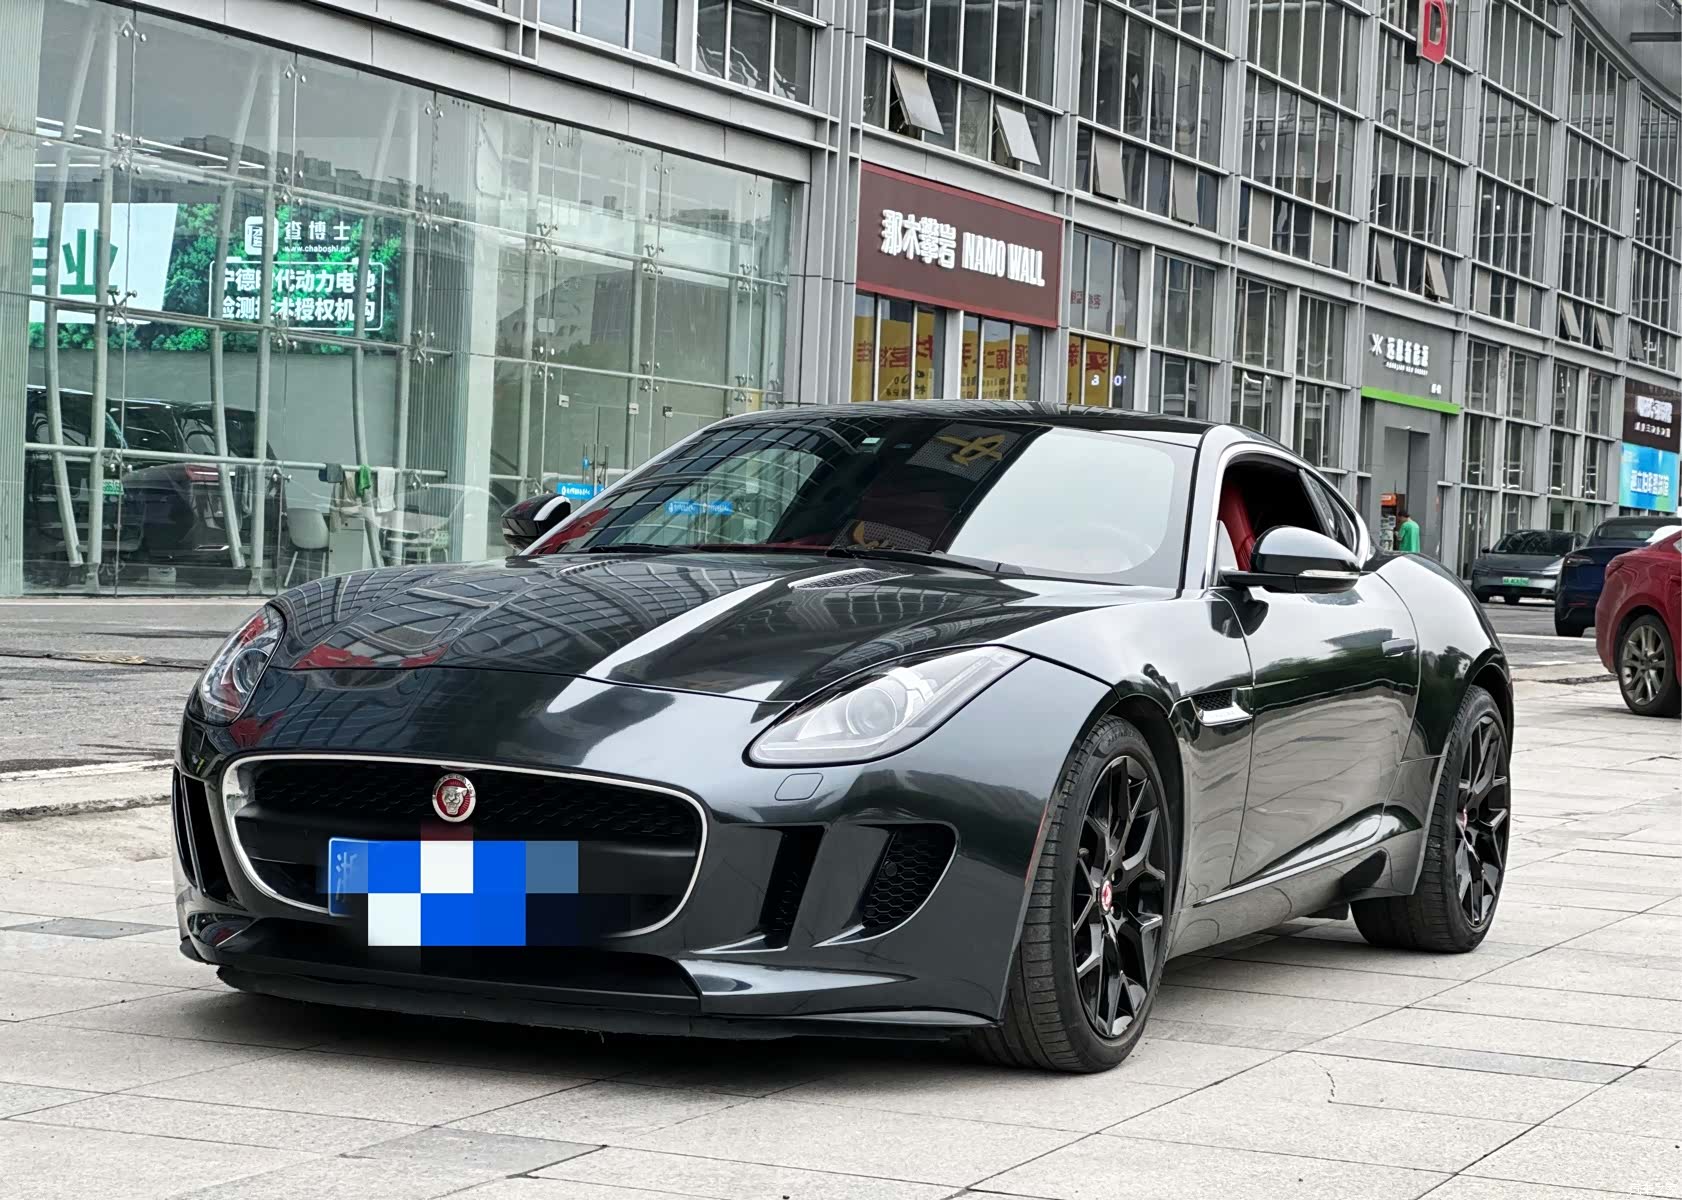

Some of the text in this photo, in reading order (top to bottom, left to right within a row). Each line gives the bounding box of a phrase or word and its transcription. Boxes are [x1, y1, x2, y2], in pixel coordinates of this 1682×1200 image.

[284, 220, 350, 240] 查博士
[881, 209, 1045, 287] 那木攀岩 NAMO WALL
